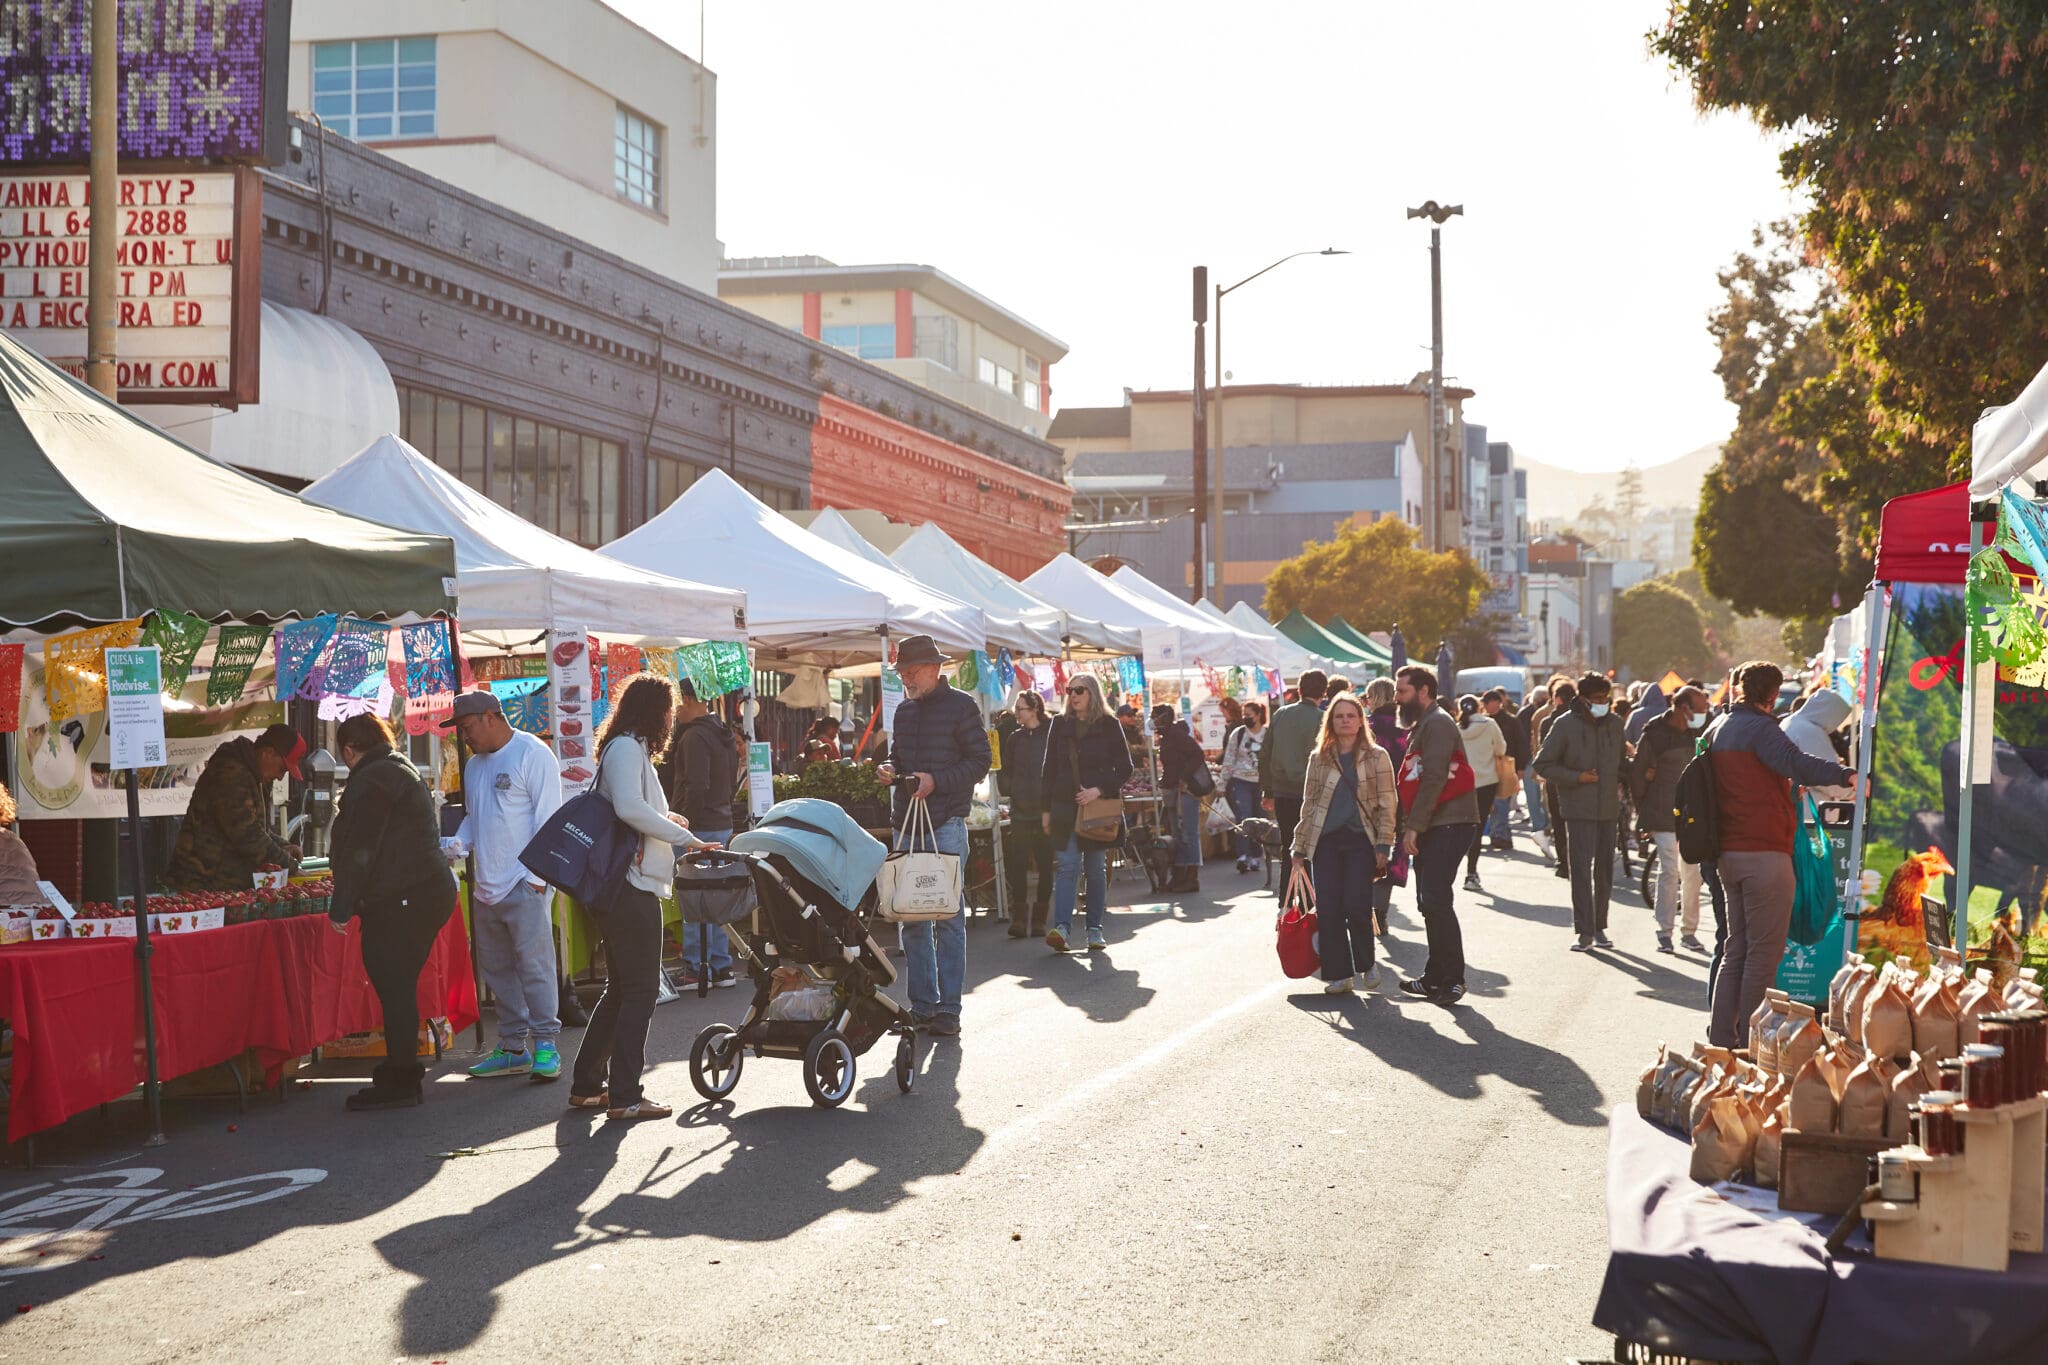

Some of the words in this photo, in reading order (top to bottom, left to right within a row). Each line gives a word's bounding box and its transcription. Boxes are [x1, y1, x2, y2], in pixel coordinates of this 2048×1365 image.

[0, 181, 70, 207] ANNA
[84, 179, 195, 207] RTY?
[0, 241, 88, 267] PYHOU
[149, 271, 186, 297] PM
[109, 654, 133, 665] CUESA
[135, 654, 144, 664] is
[564, 822, 595, 846] BELCAMP
